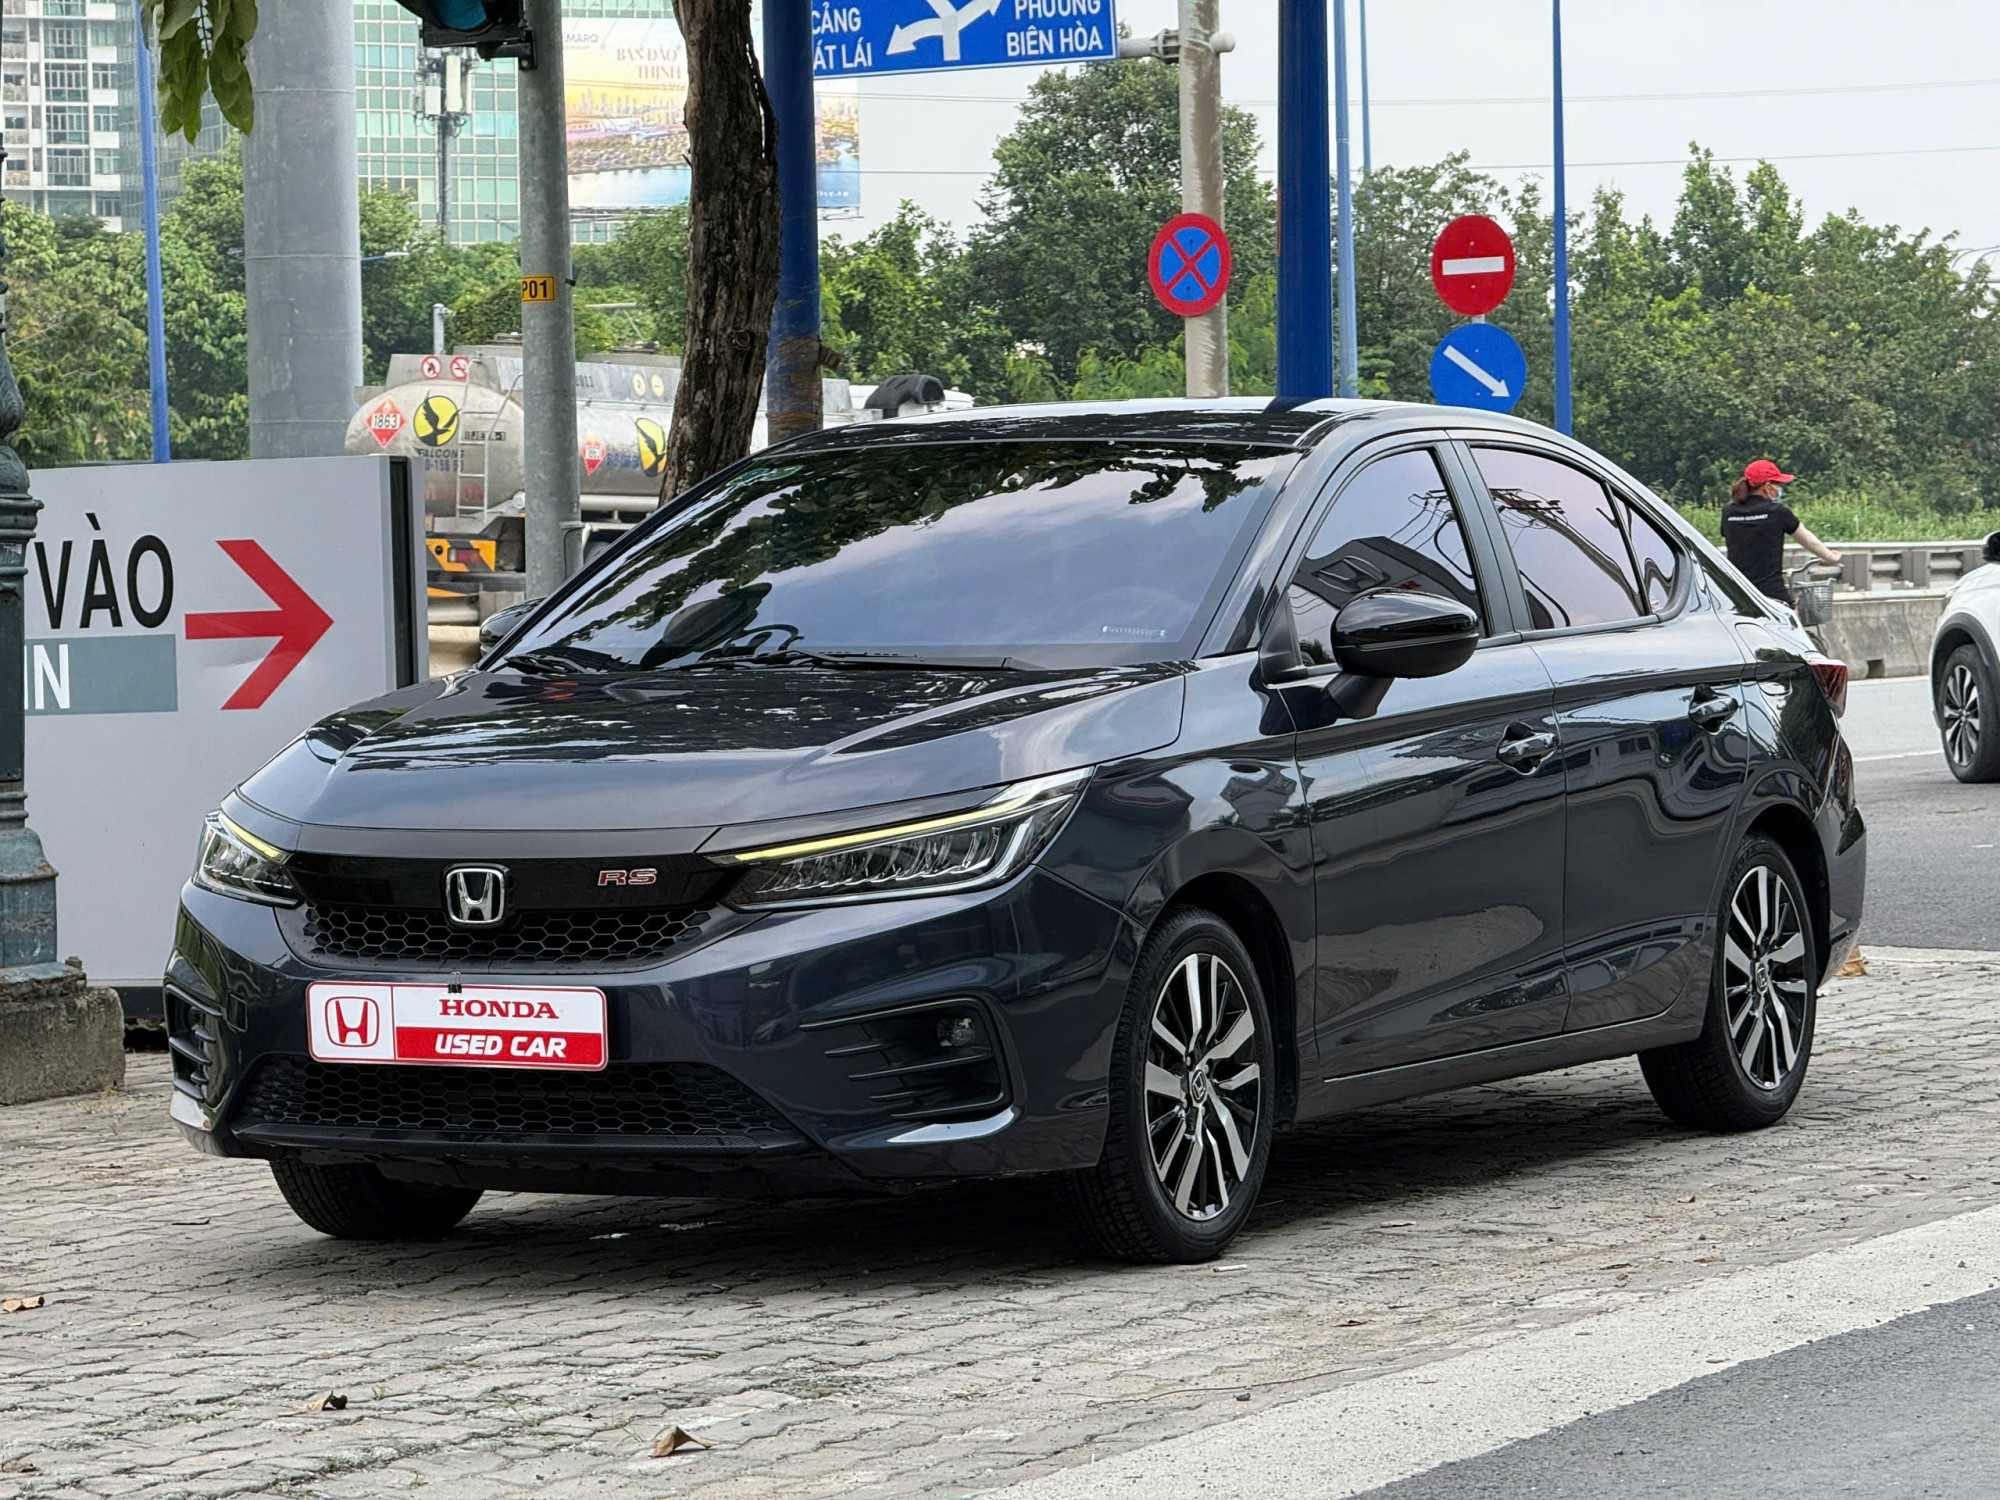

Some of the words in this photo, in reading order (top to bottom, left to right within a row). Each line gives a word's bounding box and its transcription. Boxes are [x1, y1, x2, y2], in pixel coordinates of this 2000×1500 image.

[1006, 24, 1054, 57] BIÊN
[1060, 20, 1104, 53] HÒA
[813, 39, 836, 70] ÁT
[841, 36, 873, 69] LÁI
[374, 414, 397, 429] 1863
[34, 512, 174, 630] VÀO
[597, 868, 658, 887] RS
[438, 998, 560, 1020] HONDA
[434, 1033, 502, 1055] USED
[510, 1036, 567, 1058] CAR
